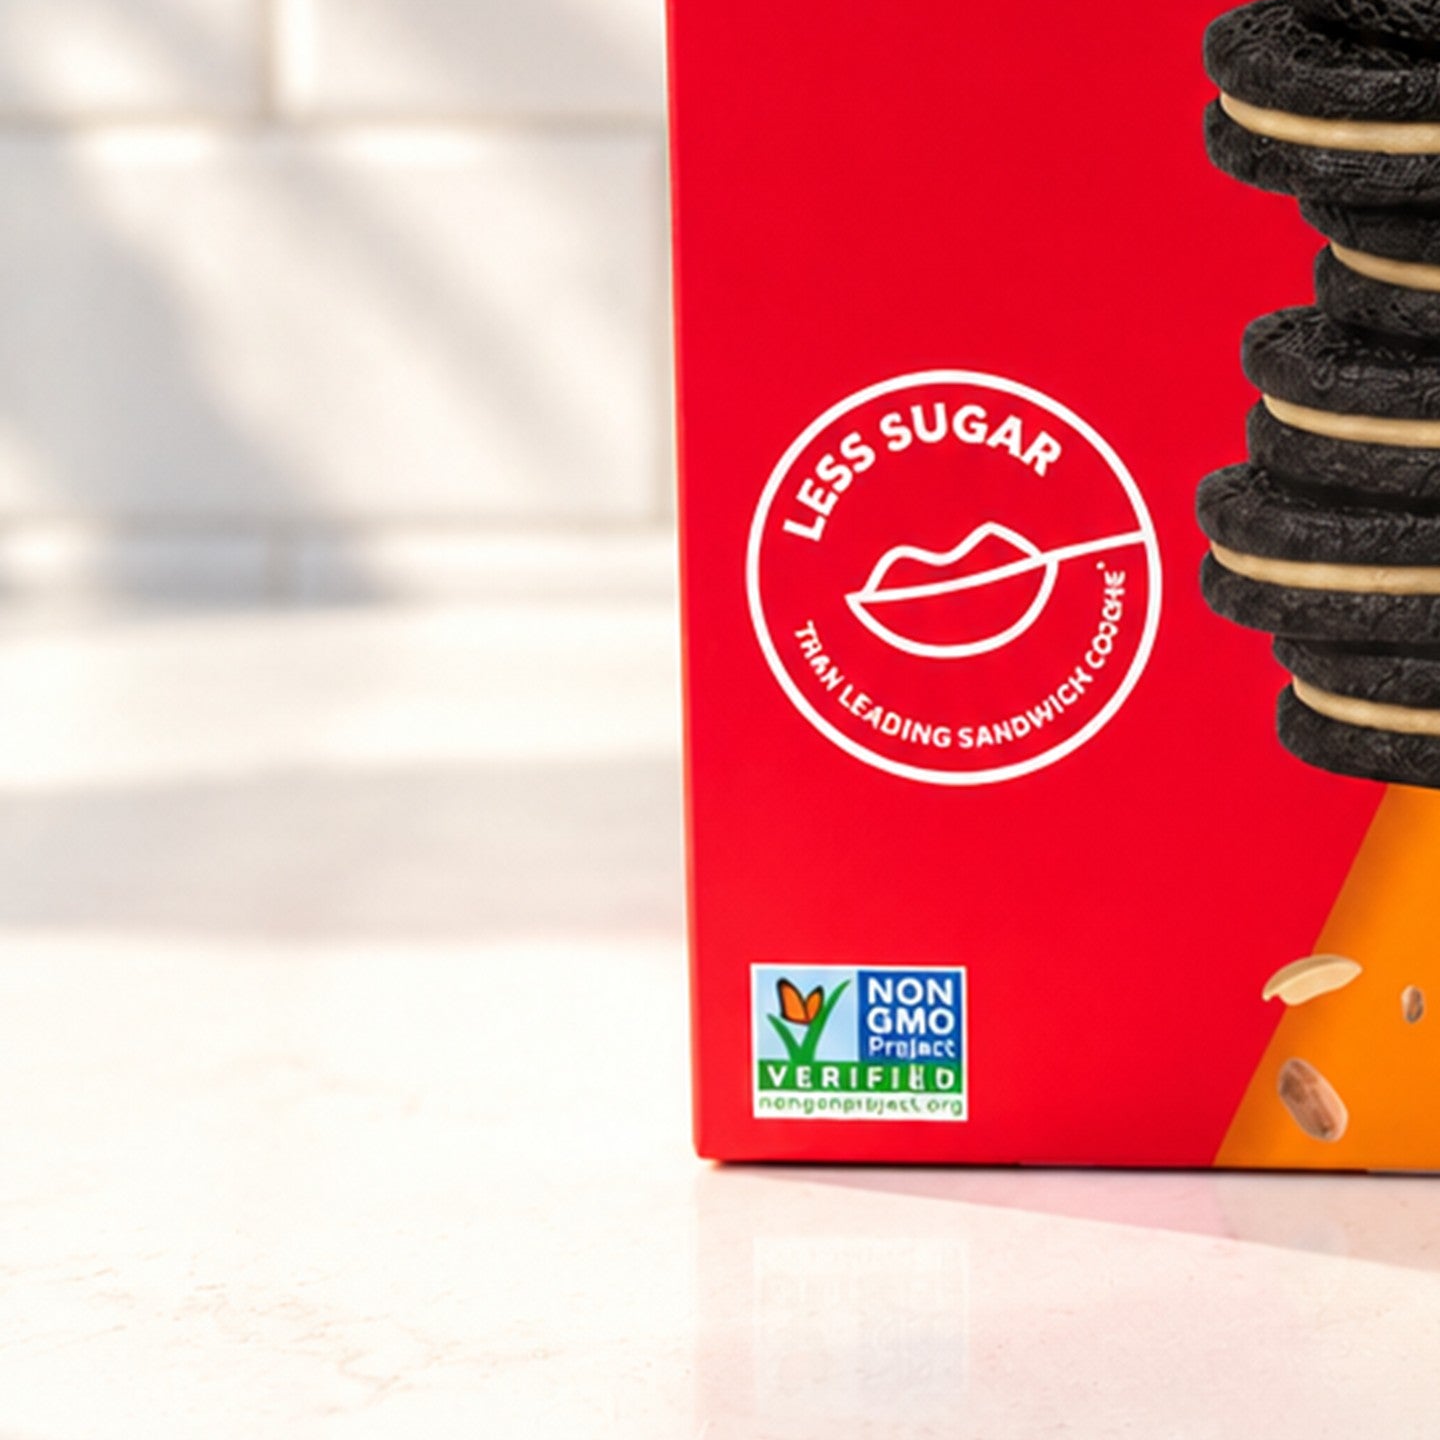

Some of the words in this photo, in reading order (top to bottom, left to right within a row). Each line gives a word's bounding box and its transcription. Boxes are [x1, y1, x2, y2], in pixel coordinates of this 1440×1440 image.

[782, 431, 876, 542] LESS
[879, 402, 1062, 478] SUGAR
[838, 684, 951, 748] LEADING
[868, 977, 953, 1006] NON
[867, 1006, 955, 1035] GMO
